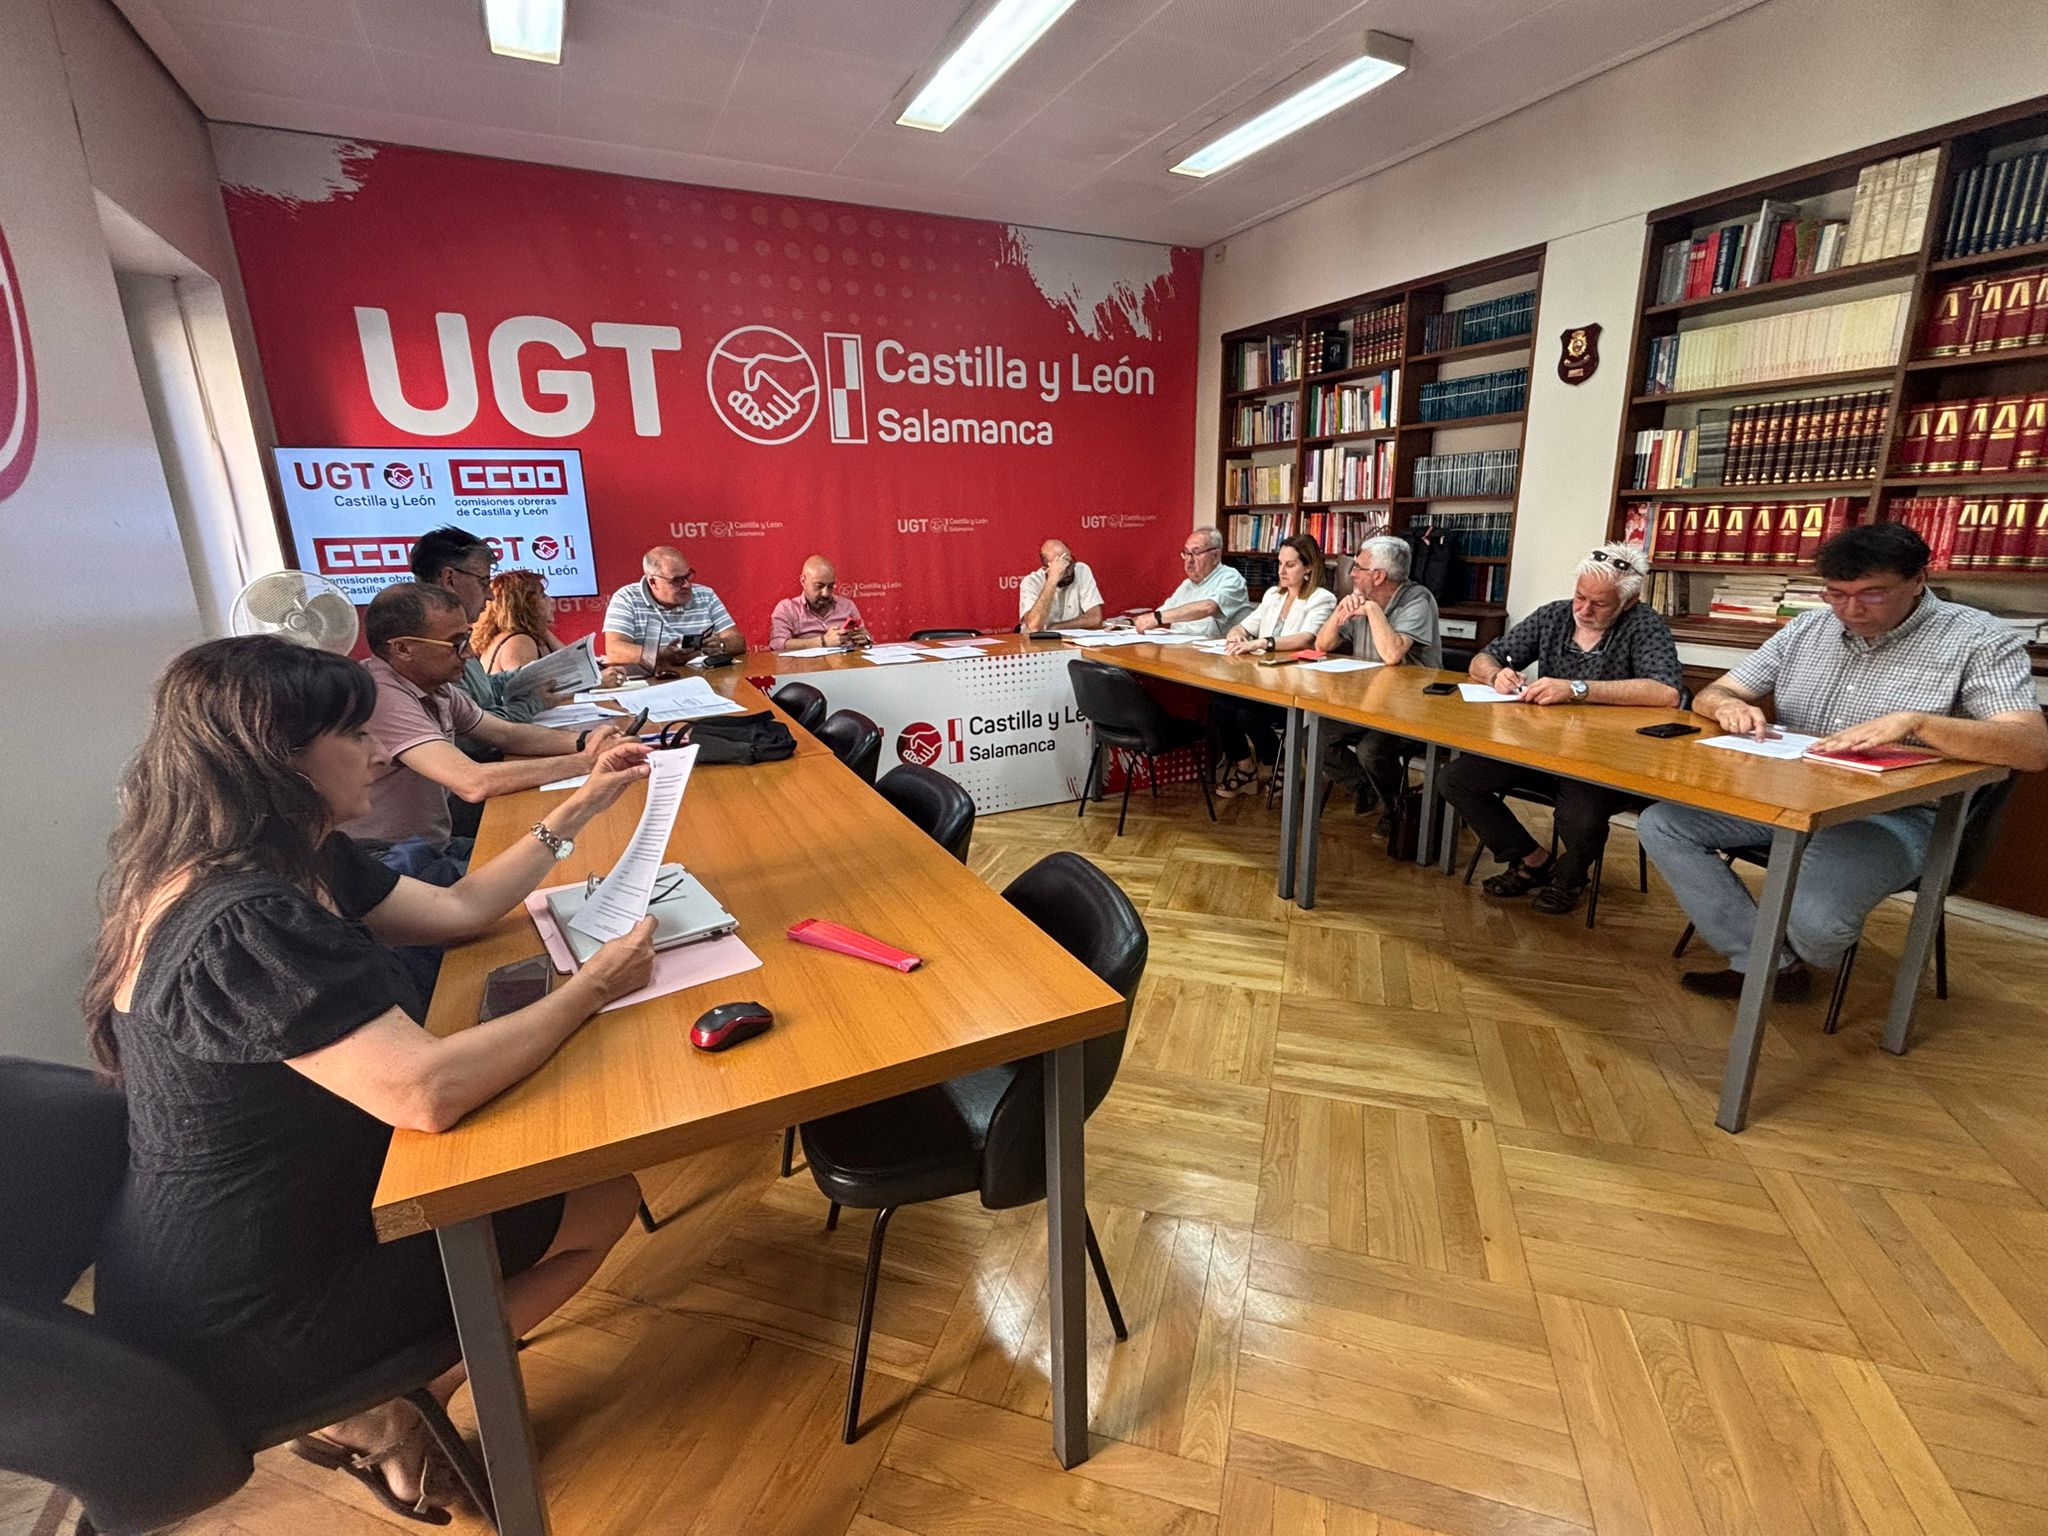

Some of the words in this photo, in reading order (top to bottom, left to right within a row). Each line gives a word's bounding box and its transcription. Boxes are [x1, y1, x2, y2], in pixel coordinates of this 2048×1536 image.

[354, 306, 682, 437] UGT
[875, 339, 1028, 390] Castilla
[1038, 361, 1061, 403] y
[1072, 353, 1155, 396] León
[878, 407, 1054, 446] Salamanca
[294, 462, 375, 490] UGT
[458, 466, 562, 489] CCOO
[334, 495, 388, 507] Castilla
[391, 499, 400, 509] y
[402, 495, 436, 506] León
[455, 498, 515, 507] comisiones
[517, 497, 557, 506] obreras
[456, 507, 470, 517] de
[472, 507, 512, 517] Castilla
[513, 510, 520, 518] y
[523, 506, 549, 515] León
[670, 522, 709, 538] UGT
[897, 518, 928, 533] UGT
[1081, 515, 1107, 529] UGT
[481, 536, 524, 561] GT
[548, 565, 578, 576] León
[388, 575, 417, 584] obre
[557, 597, 584, 613] GT
[969, 709, 1043, 736] Castilla
[1048, 711, 1059, 731] y
[1065, 705, 1086, 724] Le
[969, 739, 1056, 762] Salamanca
